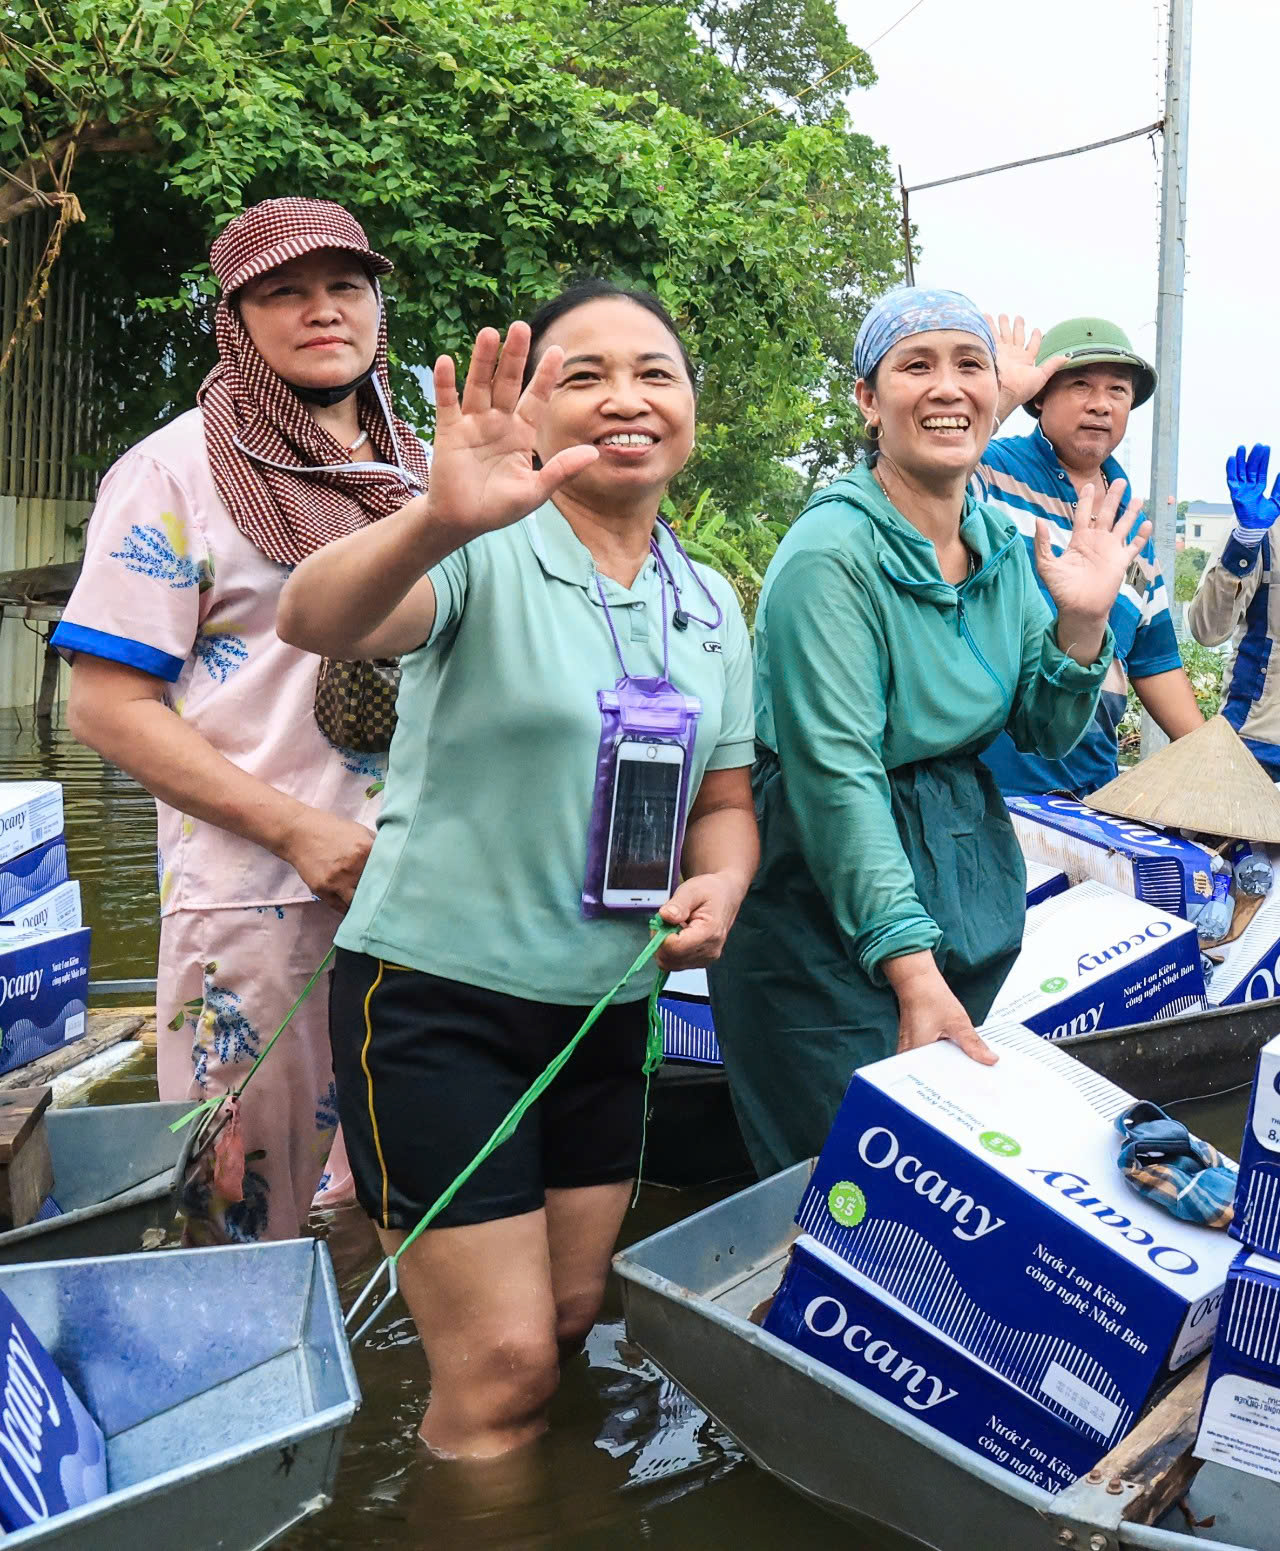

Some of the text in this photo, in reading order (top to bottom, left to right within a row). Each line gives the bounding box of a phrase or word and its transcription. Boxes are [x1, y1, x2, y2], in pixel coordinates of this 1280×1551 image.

[1078, 921, 1172, 977] Ocany
[1041, 1002, 1104, 1039] any
[858, 1126, 1005, 1241] Ocany
[1026, 1167, 1200, 1276] Ocany
[1025, 1265, 1149, 1354] công nghệ Nhật Bản
[1032, 1243, 1127, 1315] Nước I-on Kiềm
[804, 1295, 958, 1410] Ocany
[978, 1436, 1010, 1462] công
[1009, 1457, 1043, 1485] nghệ
[985, 1415, 1021, 1445] Nước
[1020, 1438, 1048, 1463] I-on
